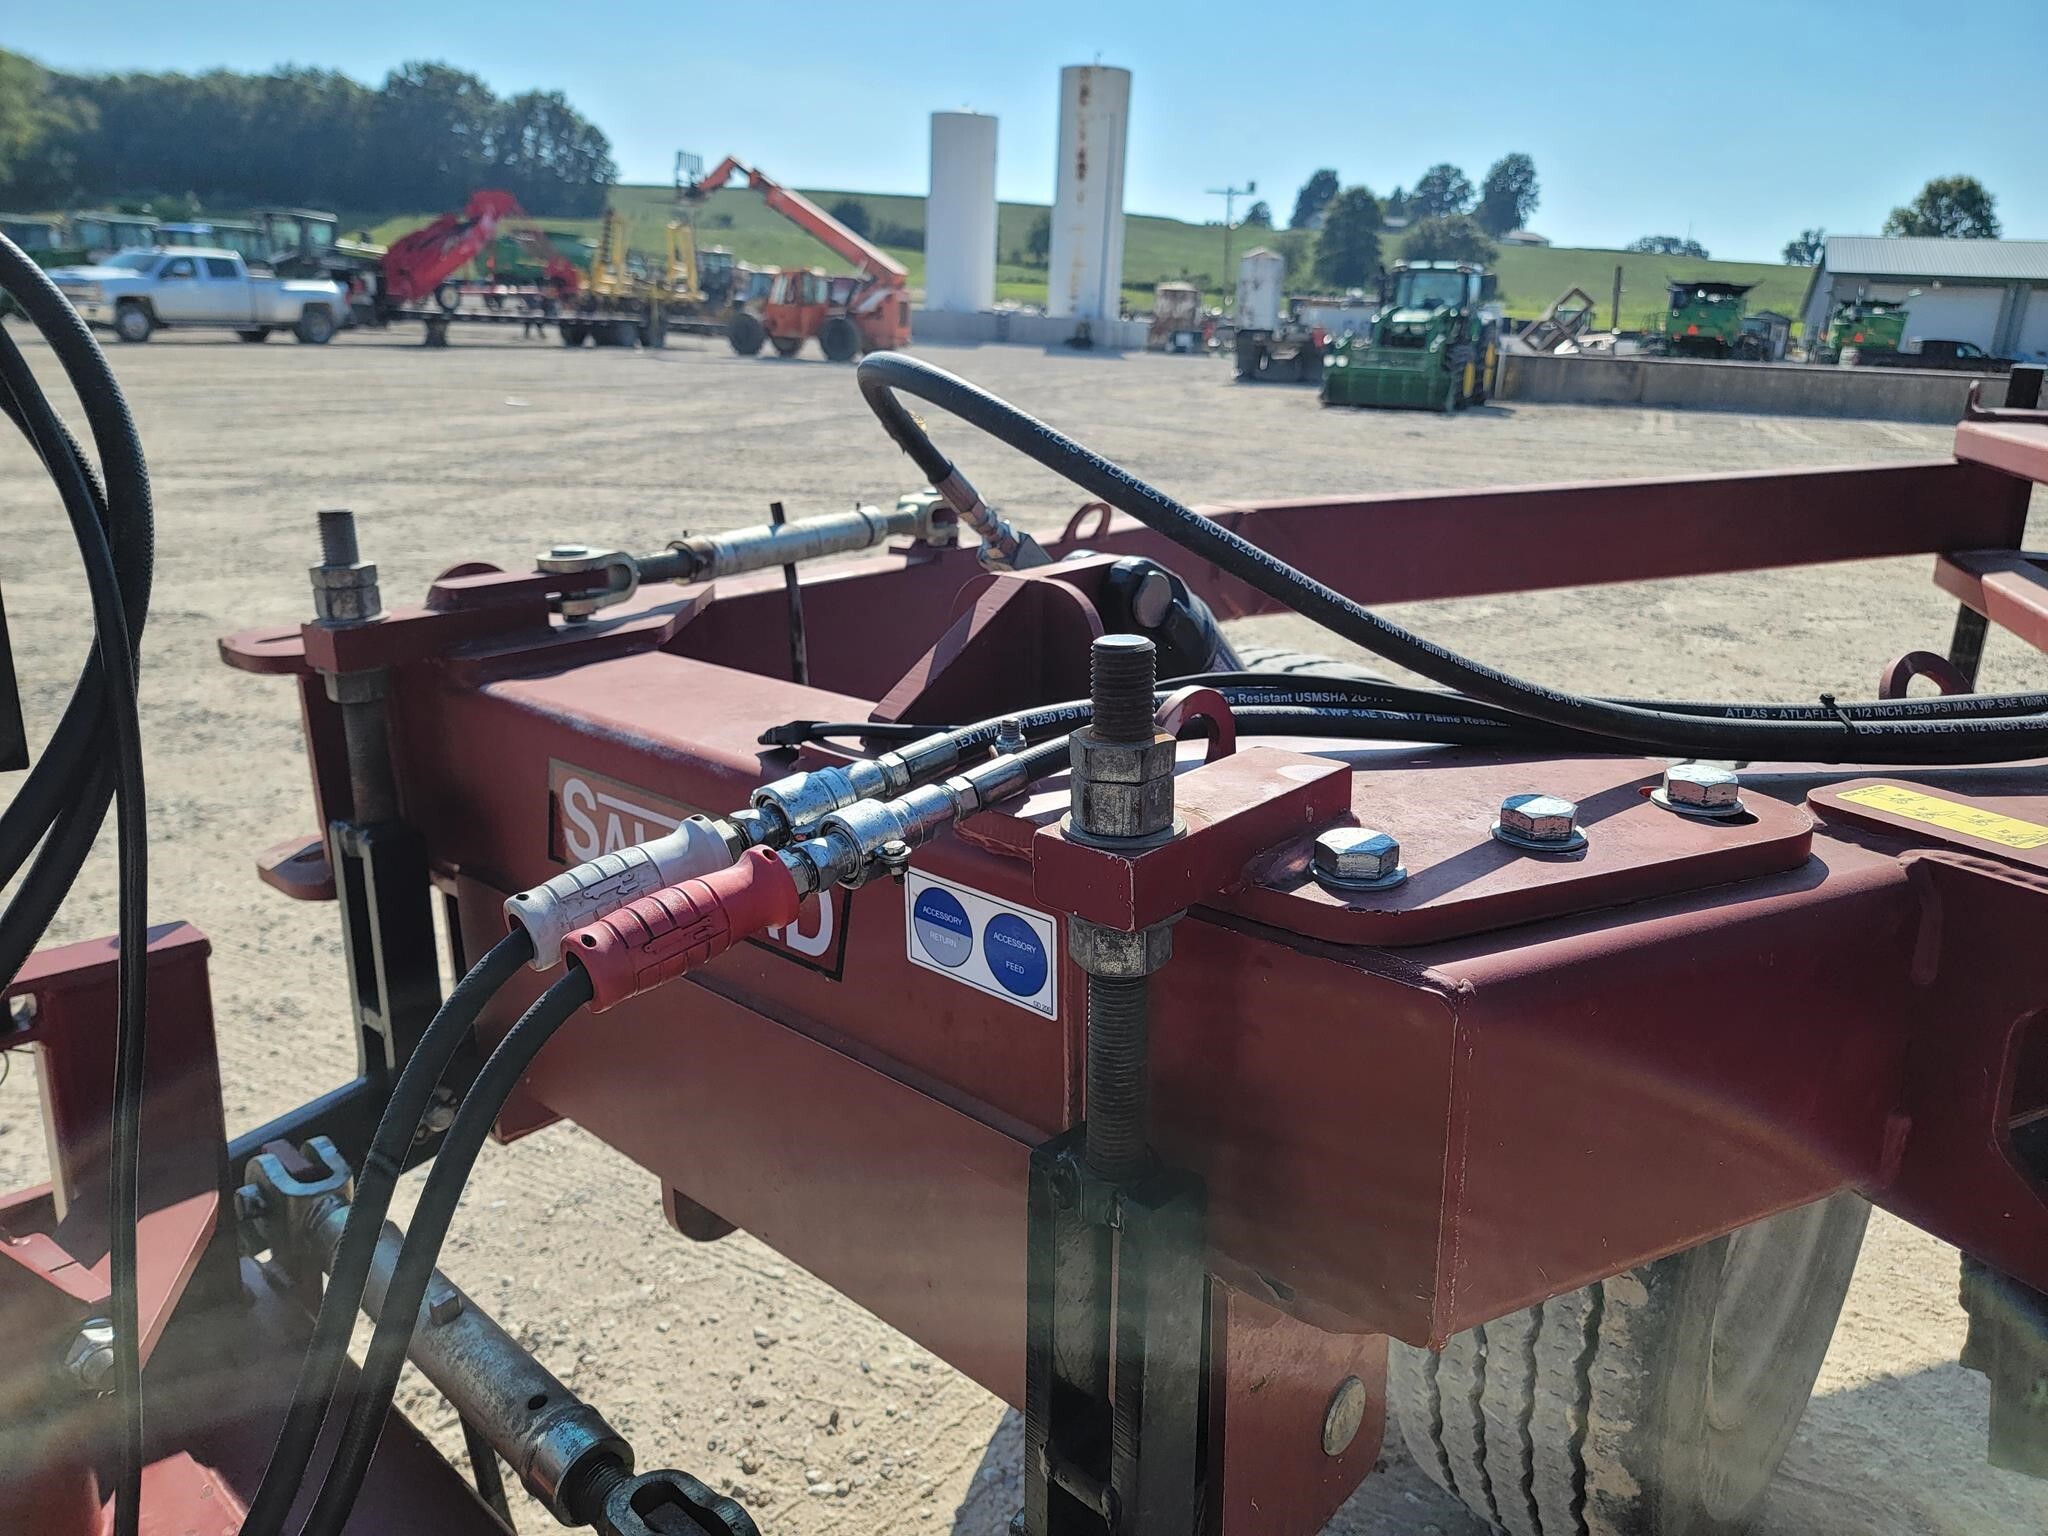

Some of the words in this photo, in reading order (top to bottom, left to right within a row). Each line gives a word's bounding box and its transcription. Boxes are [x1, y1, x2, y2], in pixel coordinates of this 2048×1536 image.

[1035, 425, 1079, 454] ATLAS
[1089, 458, 1160, 502] ATLAFLEX
[1194, 515, 1230, 542] INCH
[1231, 538, 1262, 561] 3250
[1264, 554, 1286, 576] PSI
[1288, 571, 1318, 593] MAX
[1320, 588, 1342, 604] WP
[1343, 600, 1369, 620] SAE
[1415, 637, 1448, 659] Flame
[1450, 652, 1499, 680] Resistant
[1238, 693, 1292, 704] Resistant
[1295, 692, 1349, 703] USMSHA
[1031, 713, 1057, 727] 3250
[1058, 708, 1078, 721] PSI
[1725, 707, 1768, 718] ATLAS
[1779, 708, 1839, 719] ATLAFLE
[1855, 707, 1872, 718] 1/2
[1875, 707, 1903, 718] INCH
[1905, 704, 1931, 715] 3250
[1933, 702, 1950, 713] PSI
[1952, 700, 1977, 712] MAX
[1978, 699, 1997, 710] WP
[1998, 698, 2018, 709] SAE
[1425, 713, 1461, 724] Flame
[1988, 721, 2020, 731] INCH
[922, 905, 963, 926] ACCESSORY
[929, 931, 957, 948] RETURN
[993, 932, 1037, 954] ACCESSORY
[1005, 960, 1025, 975] FEED
